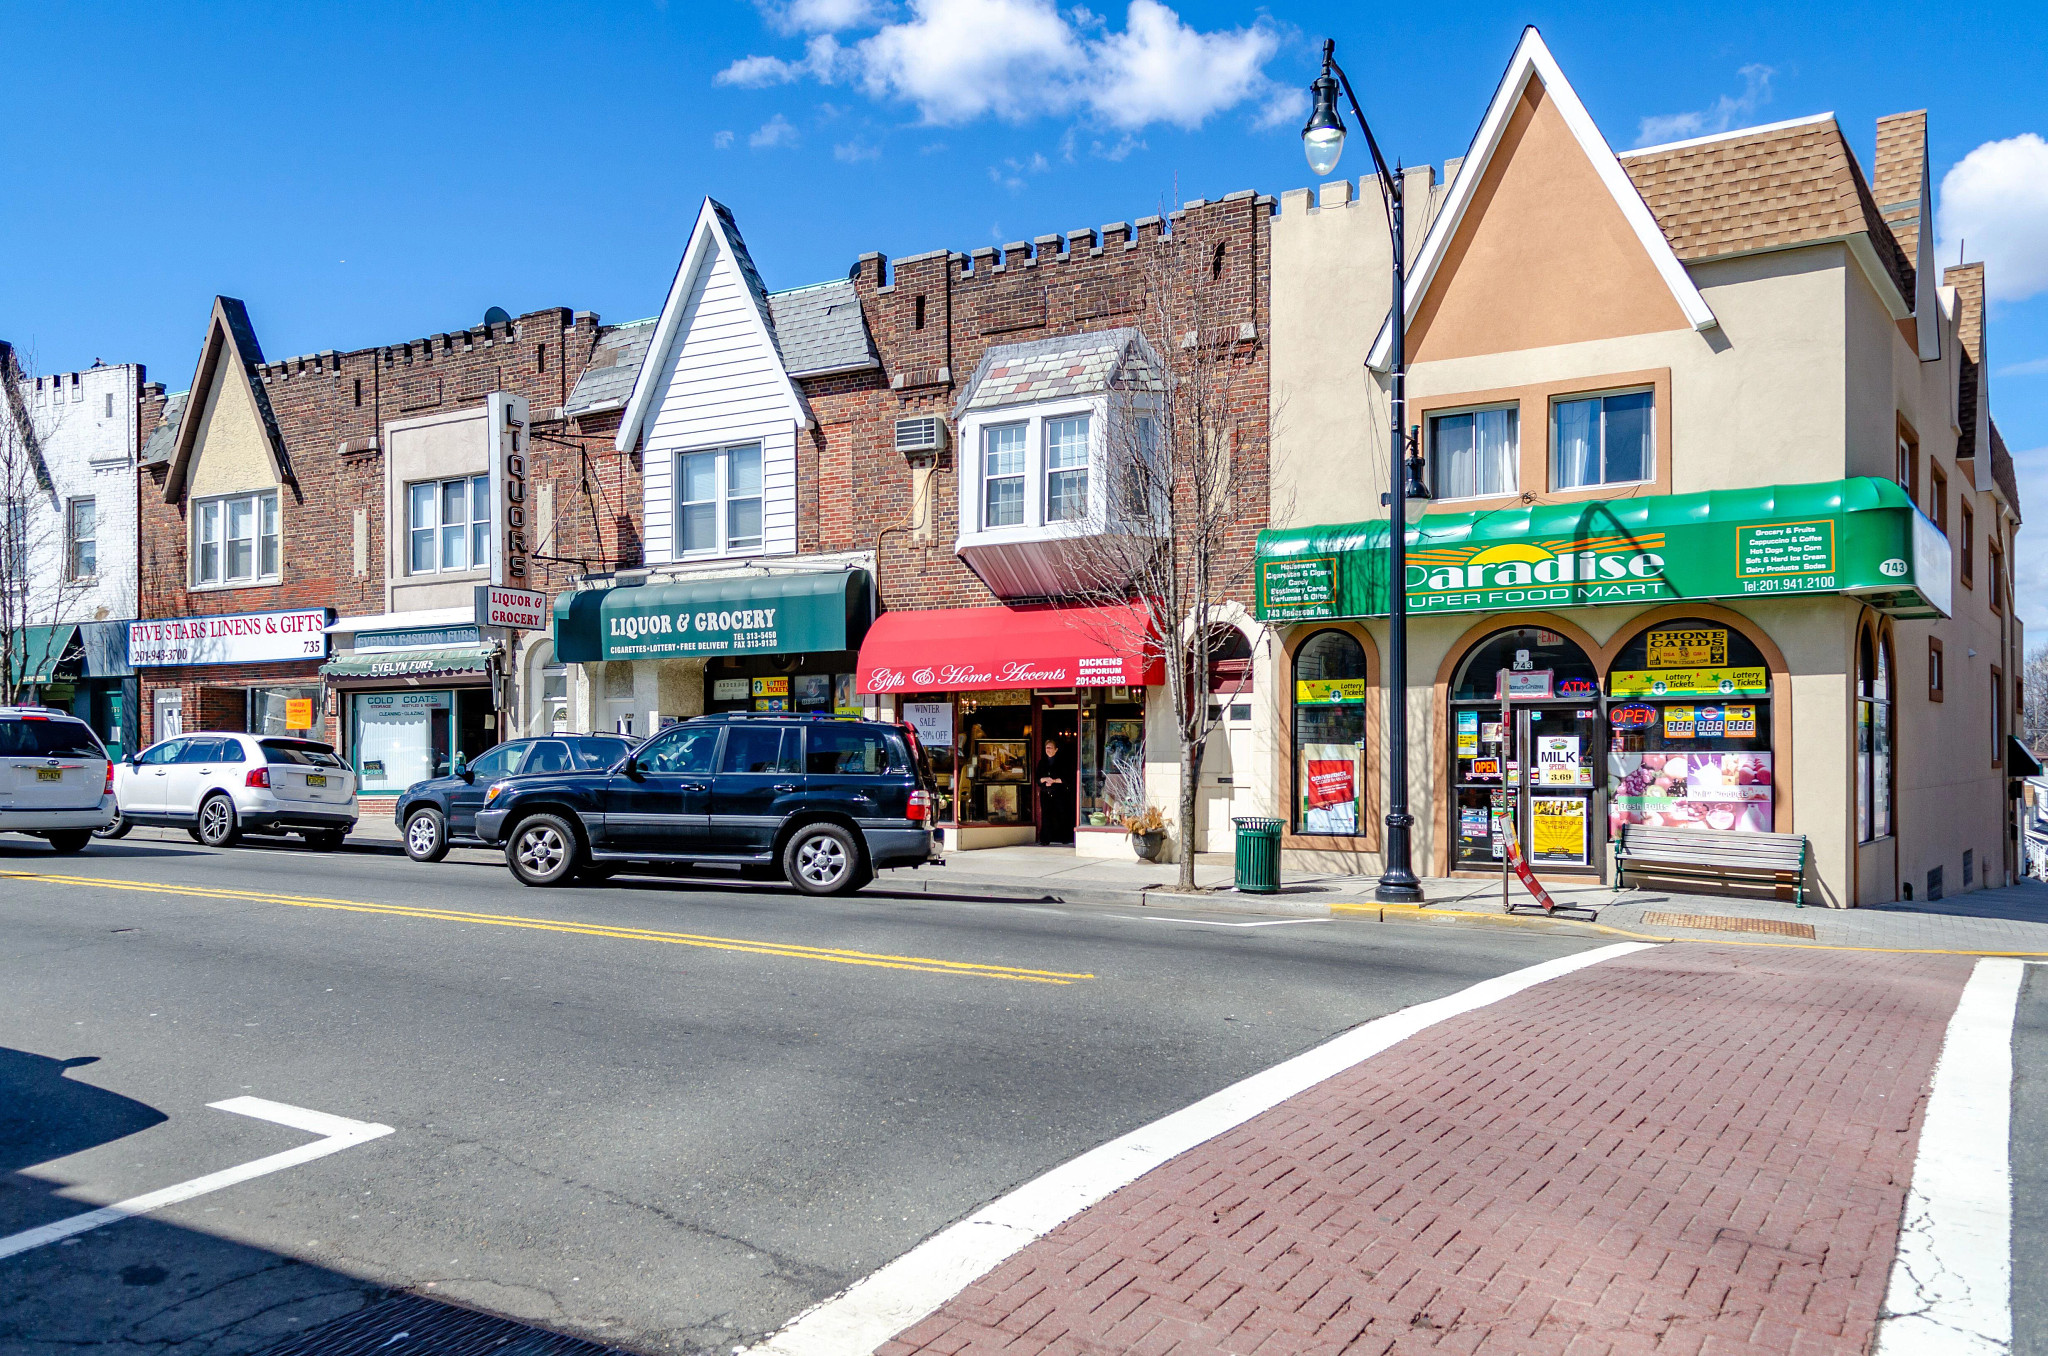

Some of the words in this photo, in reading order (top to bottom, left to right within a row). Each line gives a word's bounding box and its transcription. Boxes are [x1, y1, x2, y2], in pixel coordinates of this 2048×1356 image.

[507, 404, 528, 578] LIQUORS
[1793, 526, 1816, 534] Fruits
[1749, 538, 1790, 546] Cappuccino
[1309, 569, 1332, 577] Cigars
[1884, 563, 1905, 573] 743
[1743, 576, 1835, 592] Tel:201.941.2100
[491, 591, 532, 608] LIQUOR
[534, 597, 543, 608] &
[1408, 594, 1482, 608] UPER
[1488, 588, 1569, 603] FOOD
[1577, 582, 1666, 598] MART
[1316, 606, 1332, 615] Ave.
[491, 610, 540, 627] GROCERY
[610, 614, 673, 639] LIQUOR
[676, 613, 690, 633] &
[694, 608, 776, 632] GROCERY
[131, 625, 163, 643] FIVE
[165, 624, 207, 641] STARS
[210, 617, 261, 638] LINENS
[265, 616, 278, 634] &
[280, 613, 323, 634] GIFTS
[356, 633, 397, 649] EVELYN
[400, 631, 444, 645] FASHION
[446, 629, 477, 642] FURS
[746, 631, 777, 640] 313-5450
[1650, 632, 1725, 640] PHONE
[303, 640, 321, 653] 735
[610, 645, 647, 654] CIGARETTES
[649, 643, 677, 653] LOTTERY
[680, 643, 697, 651] FREE
[697, 641, 729, 650] DELIVERY
[733, 641, 746, 649] FAX
[746, 639, 778, 648] 313-9130
[1650, 638, 1724, 648] CARDS
[134, 648, 188, 662] 201-943-3700
[371, 660, 408, 673] EVELYN
[409, 659, 434, 671] FURS
[1078, 657, 1123, 668] DICKENS
[1514, 662, 1532, 670] 743
[1079, 666, 1122, 675] EMPORIUM
[1733, 671, 1761, 680] Lottery
[867, 667, 906, 693] Gifts
[912, 667, 936, 686] &
[937, 664, 992, 685] Home
[995, 661, 1067, 683] Accents
[1075, 675, 1126, 686] 201-943-8593
[1665, 673, 1692, 681] Lottery
[1341, 682, 1363, 690] Lottery
[1562, 681, 1590, 692] ATM
[1669, 680, 1695, 688] Tickets
[1737, 678, 1763, 687] Tickets
[367, 696, 394, 705] COLD
[403, 695, 438, 704] COATS
[914, 704, 940, 714] WINTER
[1611, 708, 1656, 723] OPEN
[919, 717, 937, 727] SALE
[935, 730, 948, 740] OFF
[1541, 751, 1576, 763] MILK
[1474, 760, 1498, 773] OPEN
[1550, 773, 1572, 781] 3.69
[1619, 803, 1642, 811] Fresh
[1644, 802, 1668, 811] Fruits
